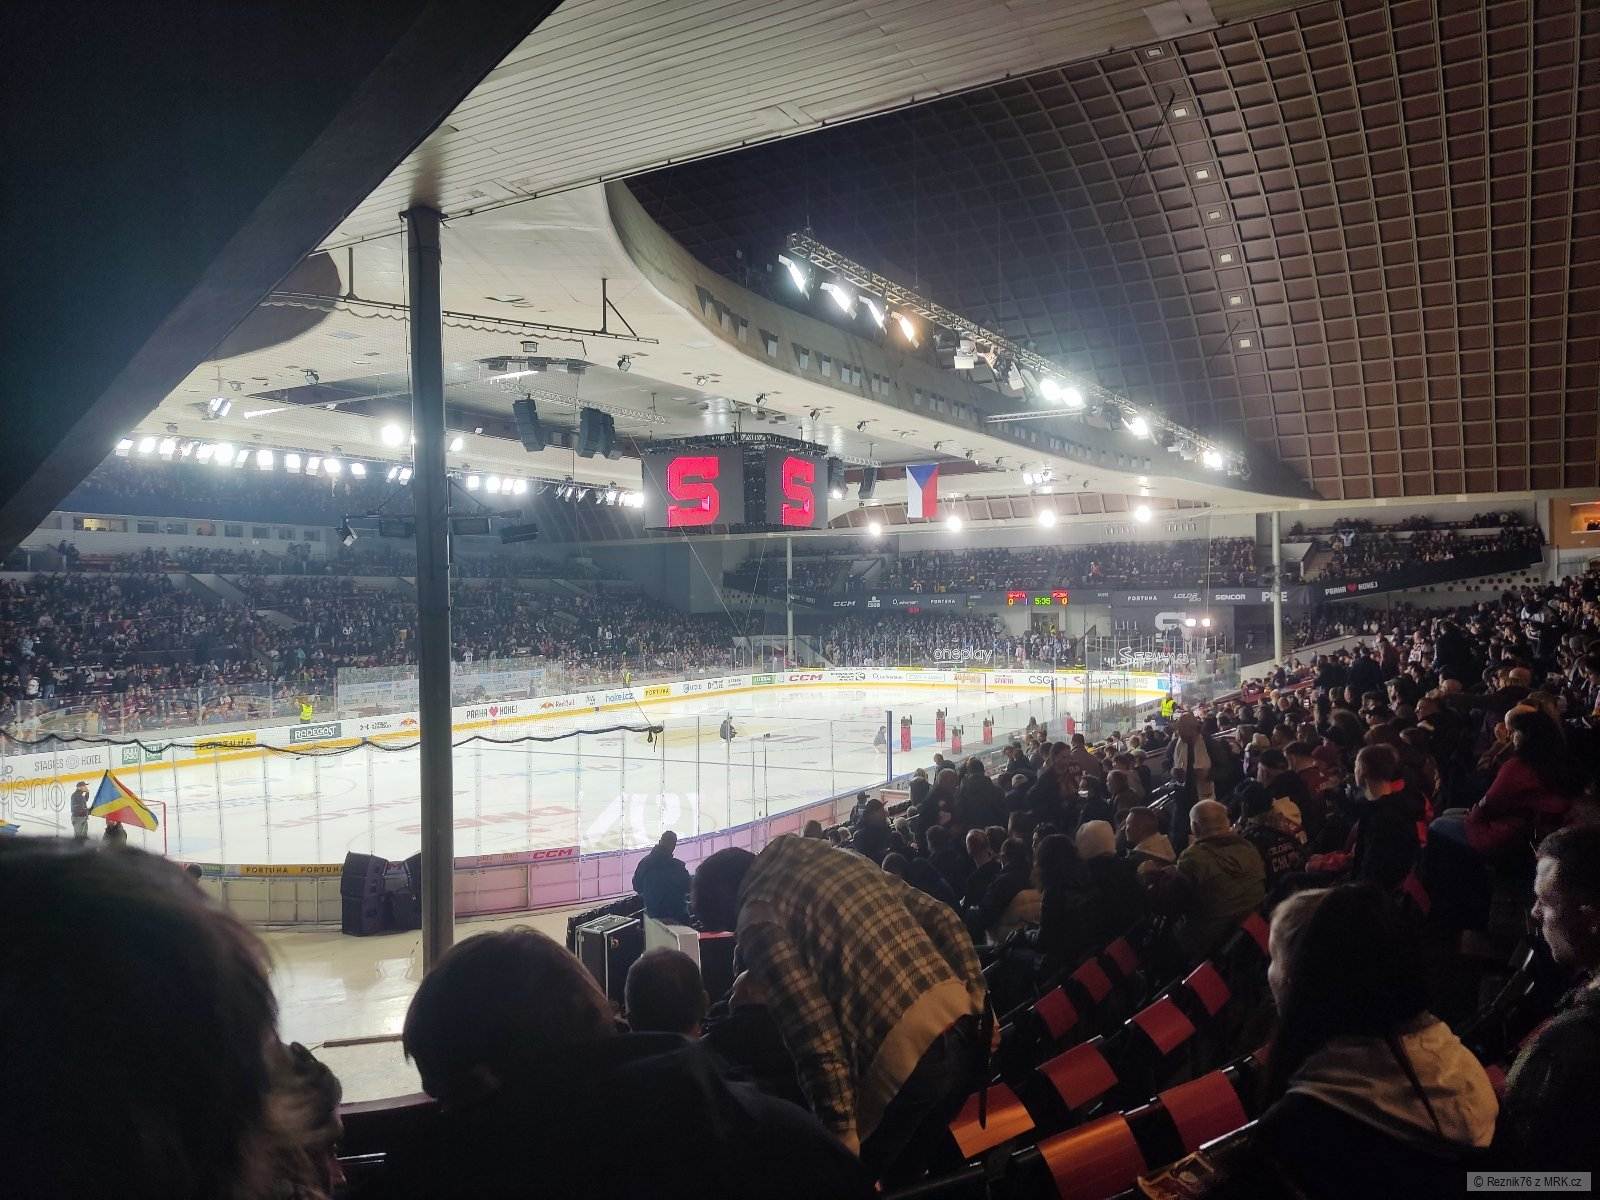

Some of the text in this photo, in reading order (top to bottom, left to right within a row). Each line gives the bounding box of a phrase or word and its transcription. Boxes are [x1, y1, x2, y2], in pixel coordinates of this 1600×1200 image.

[667, 456, 719, 528] S
[782, 456, 816, 528] S
[934, 645, 993, 664] oneplay
[789, 673, 823, 682] CCM
[81, 754, 102, 766] HOTEL
[533, 849, 572, 859] CCM
